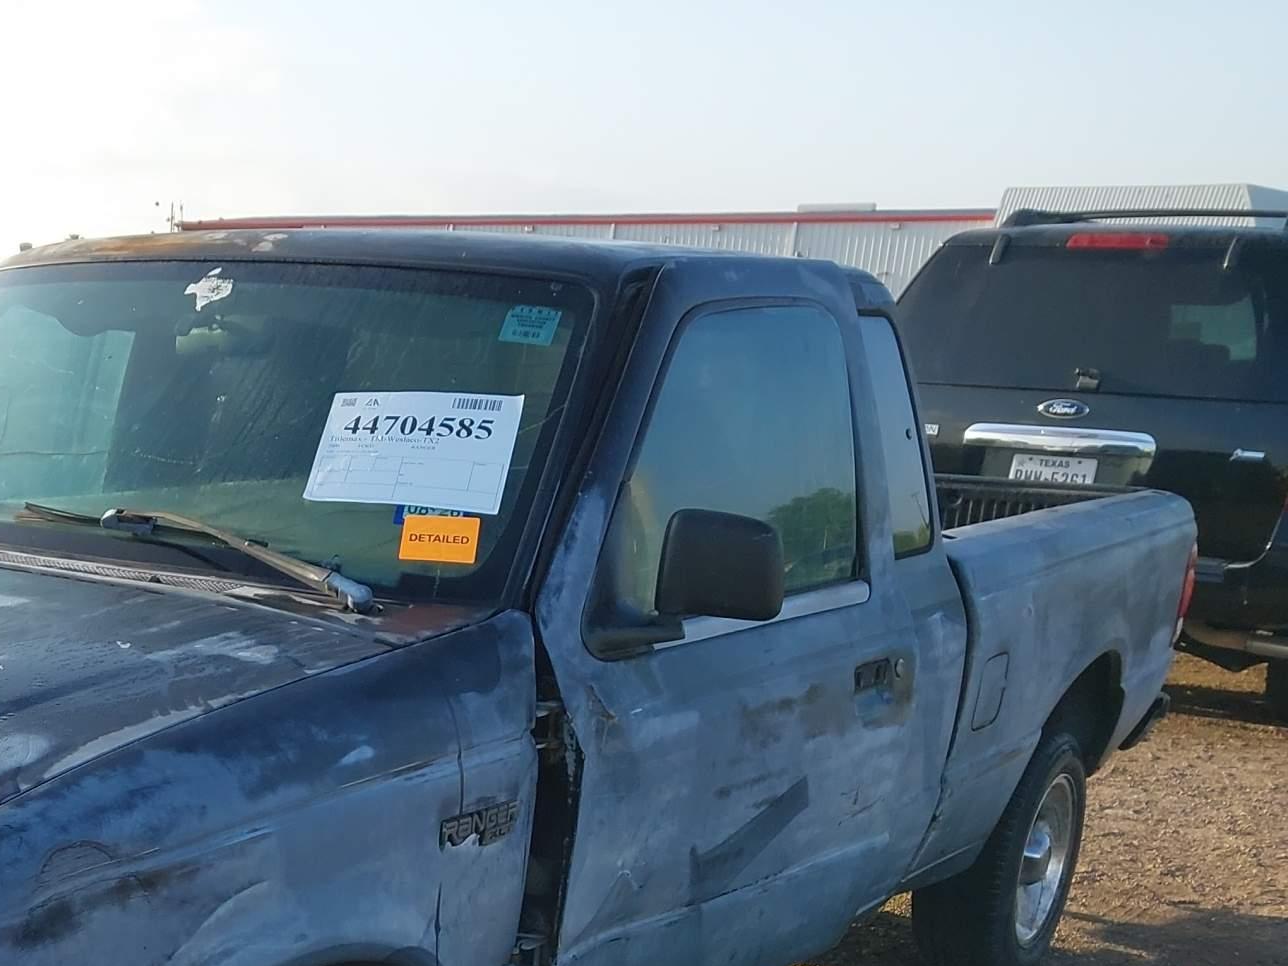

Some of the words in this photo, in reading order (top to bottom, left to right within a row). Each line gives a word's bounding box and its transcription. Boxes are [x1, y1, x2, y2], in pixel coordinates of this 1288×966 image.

[1049, 401, 1078, 414] Ford
[343, 415, 495, 440] 44704585
[1039, 458, 1071, 469] TEXAS
[409, 533, 470, 545] DETAILED
